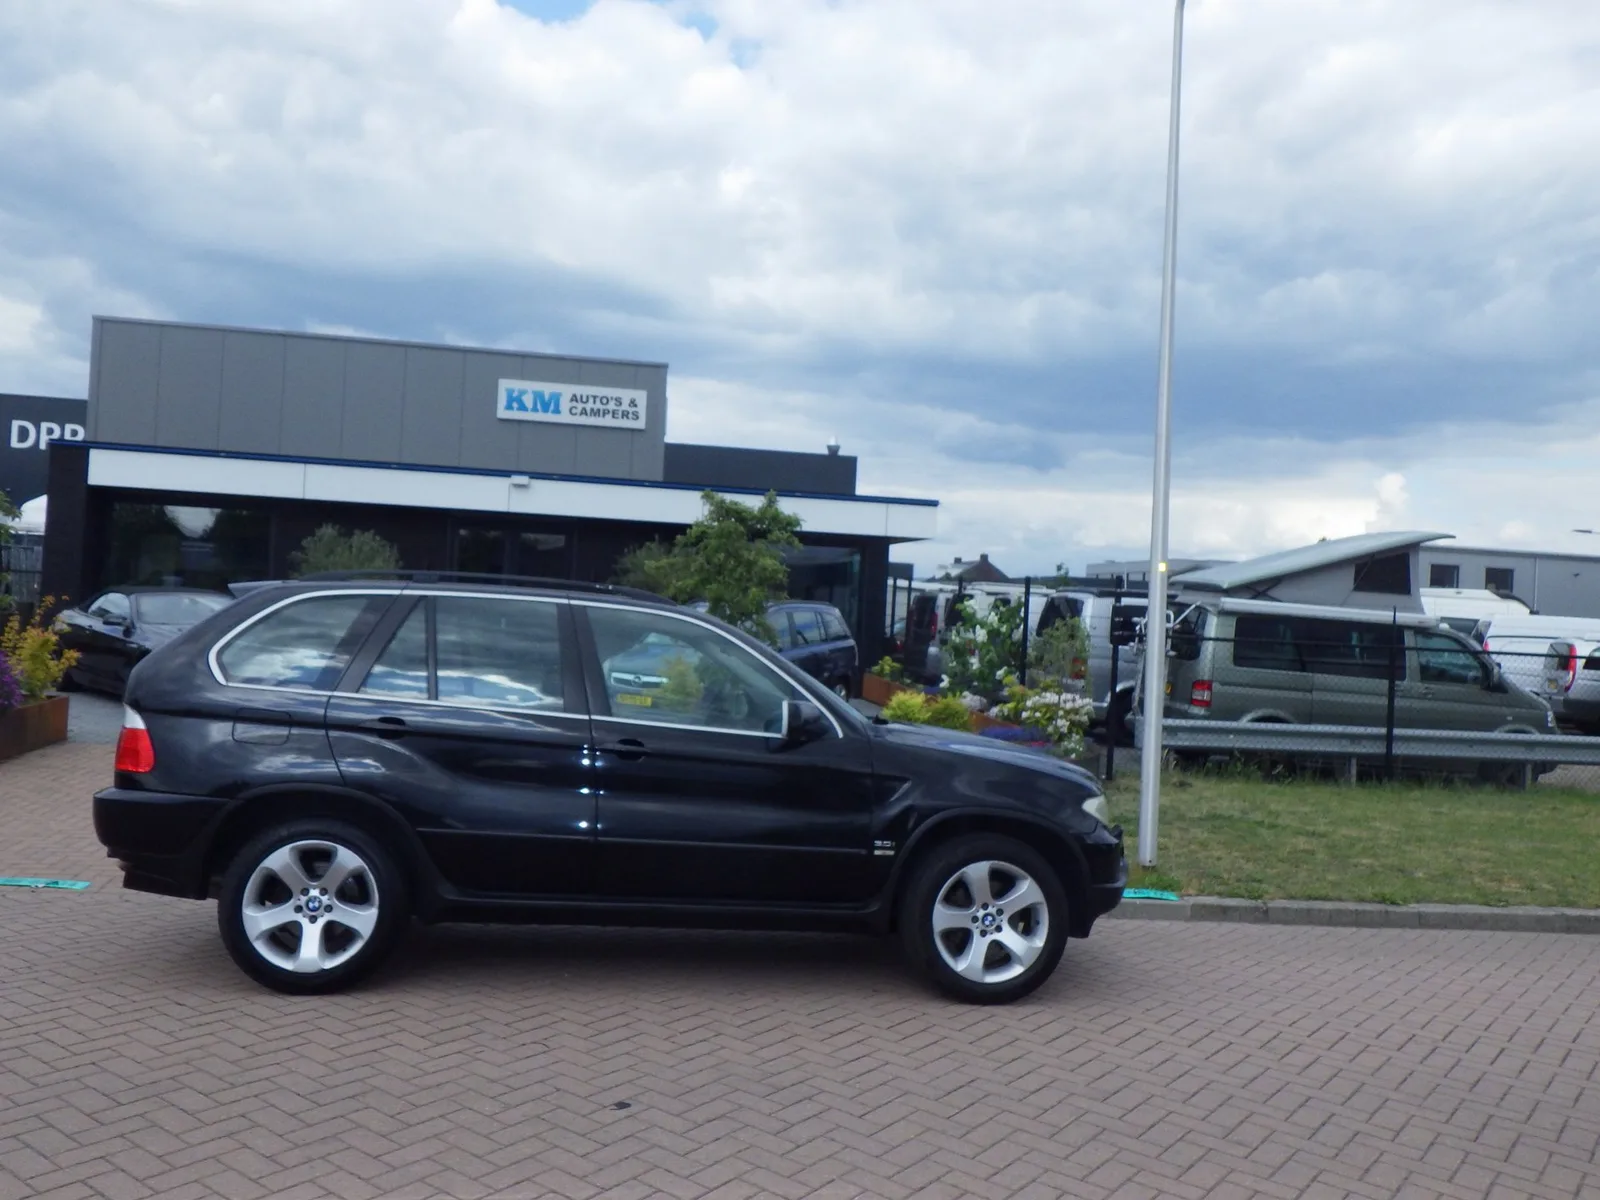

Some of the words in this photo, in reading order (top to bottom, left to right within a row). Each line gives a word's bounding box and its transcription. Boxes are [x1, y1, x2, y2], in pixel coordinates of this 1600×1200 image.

[504, 387, 562, 415] KM
[569, 393, 622, 407] AUTO'S
[628, 398, 638, 408] &
[568, 406, 640, 421] CAMPERS
